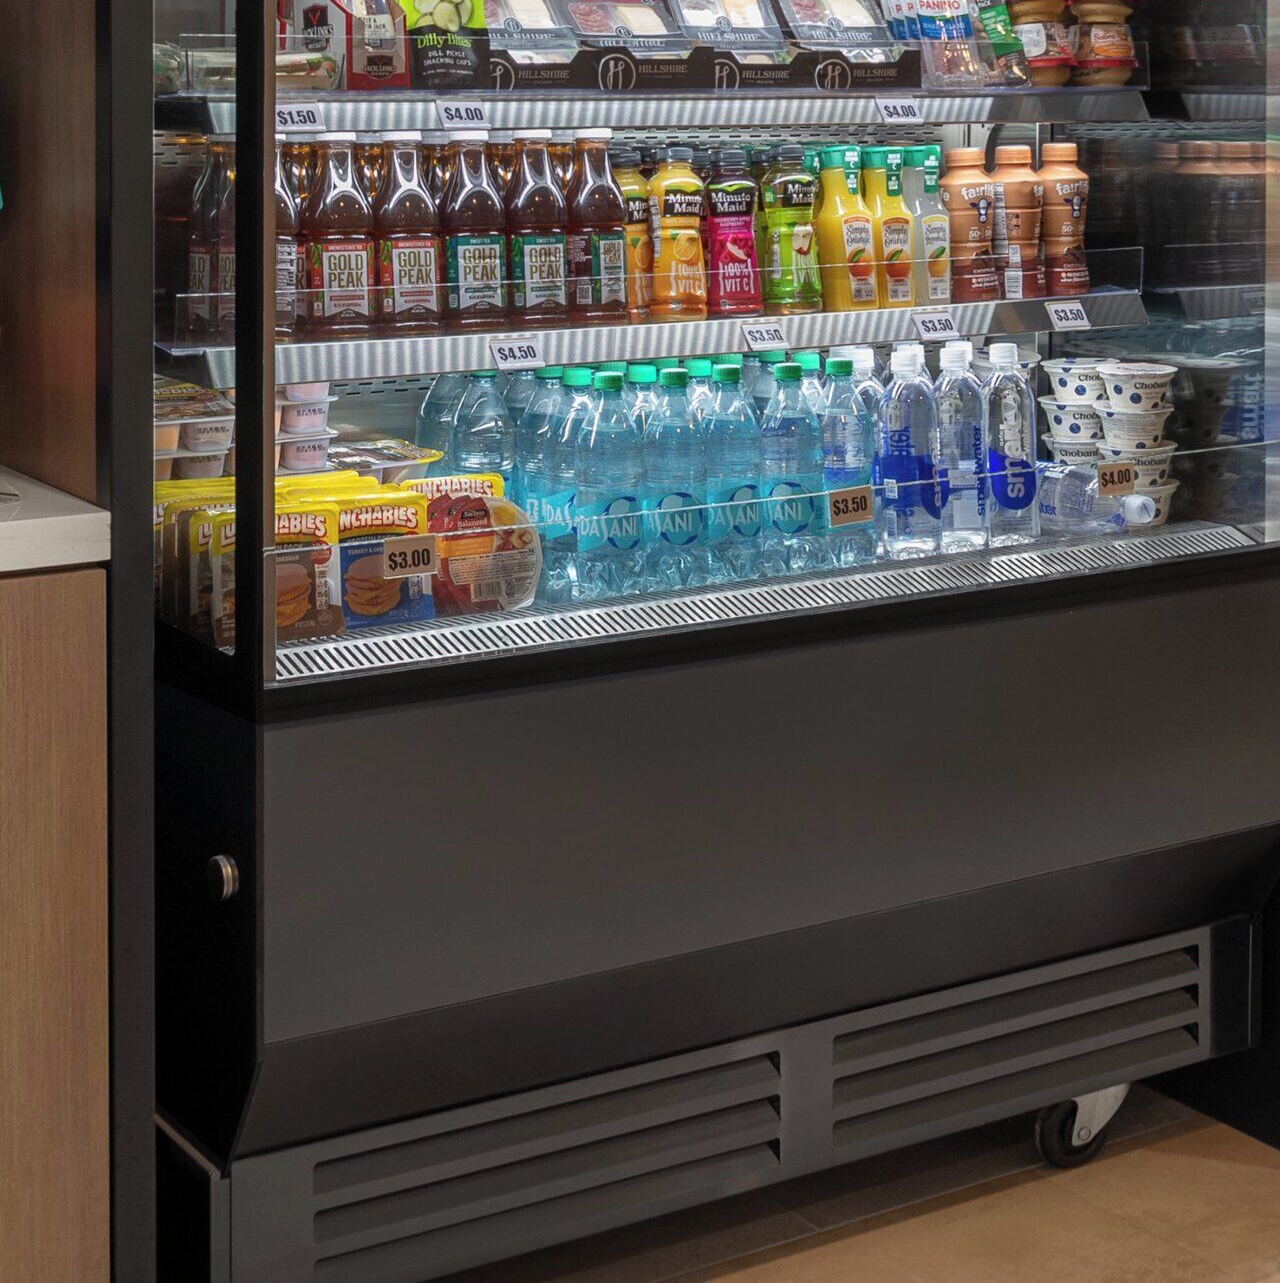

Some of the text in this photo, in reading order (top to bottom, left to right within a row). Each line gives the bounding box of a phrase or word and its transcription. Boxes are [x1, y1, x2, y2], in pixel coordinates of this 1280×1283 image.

[919, 0, 961, 12] PANINO
[417, 33, 472, 49] Dilly Bites
[697, 31, 760, 42] HILLSHIRE
[811, 30, 872, 41] HILLSHIRE
[427, 49, 466, 58] DILL PICKLE
[423, 57, 472, 67] SNACKING CHIPS
[638, 64, 689, 74] HILLSHIRE
[518, 69, 570, 80] HILLSHIRE
[741, 69, 790, 80] HILLSHIRE
[852, 68, 899, 78] HILLSHIRE
[276, 109, 318, 126] $1.50
[443, 106, 485, 123] $4.00
[883, 104, 917, 118] $4.00
[668, 193, 703, 205] Minute
[711, 192, 752, 204] Minute
[673, 202, 700, 214] Maid
[716, 201, 747, 213] Maid
[846, 224, 871, 239] Simply
[883, 224, 909, 238] Simply
[603, 241, 621, 254] GOLD
[846, 235, 871, 249] Orange
[884, 235, 909, 248] Orange
[327, 253, 364, 271] GOLD
[397, 250, 432, 269] GOLD
[462, 247, 498, 264] GOLD
[529, 246, 561, 264] GOLD
[398, 267, 433, 285] PEAK
[462, 264, 498, 282] PEAK
[529, 263, 562, 280] PEAK
[723, 262, 751, 278] 100%
[328, 271, 364, 289] PEAK
[677, 278, 694, 293] VIT
[724, 277, 751, 293] VIT C
[1053, 309, 1086, 322] $3.50
[921, 318, 954, 333] $3.50
[747, 328, 783, 343] $3.50
[497, 344, 537, 362] $4.50
[1100, 468, 1131, 488] $4.00
[832, 495, 868, 516] $3.50
[457, 518, 488, 528] Balanced
[580, 518, 637, 542] DASANI
[387, 547, 431, 572] $3.00
